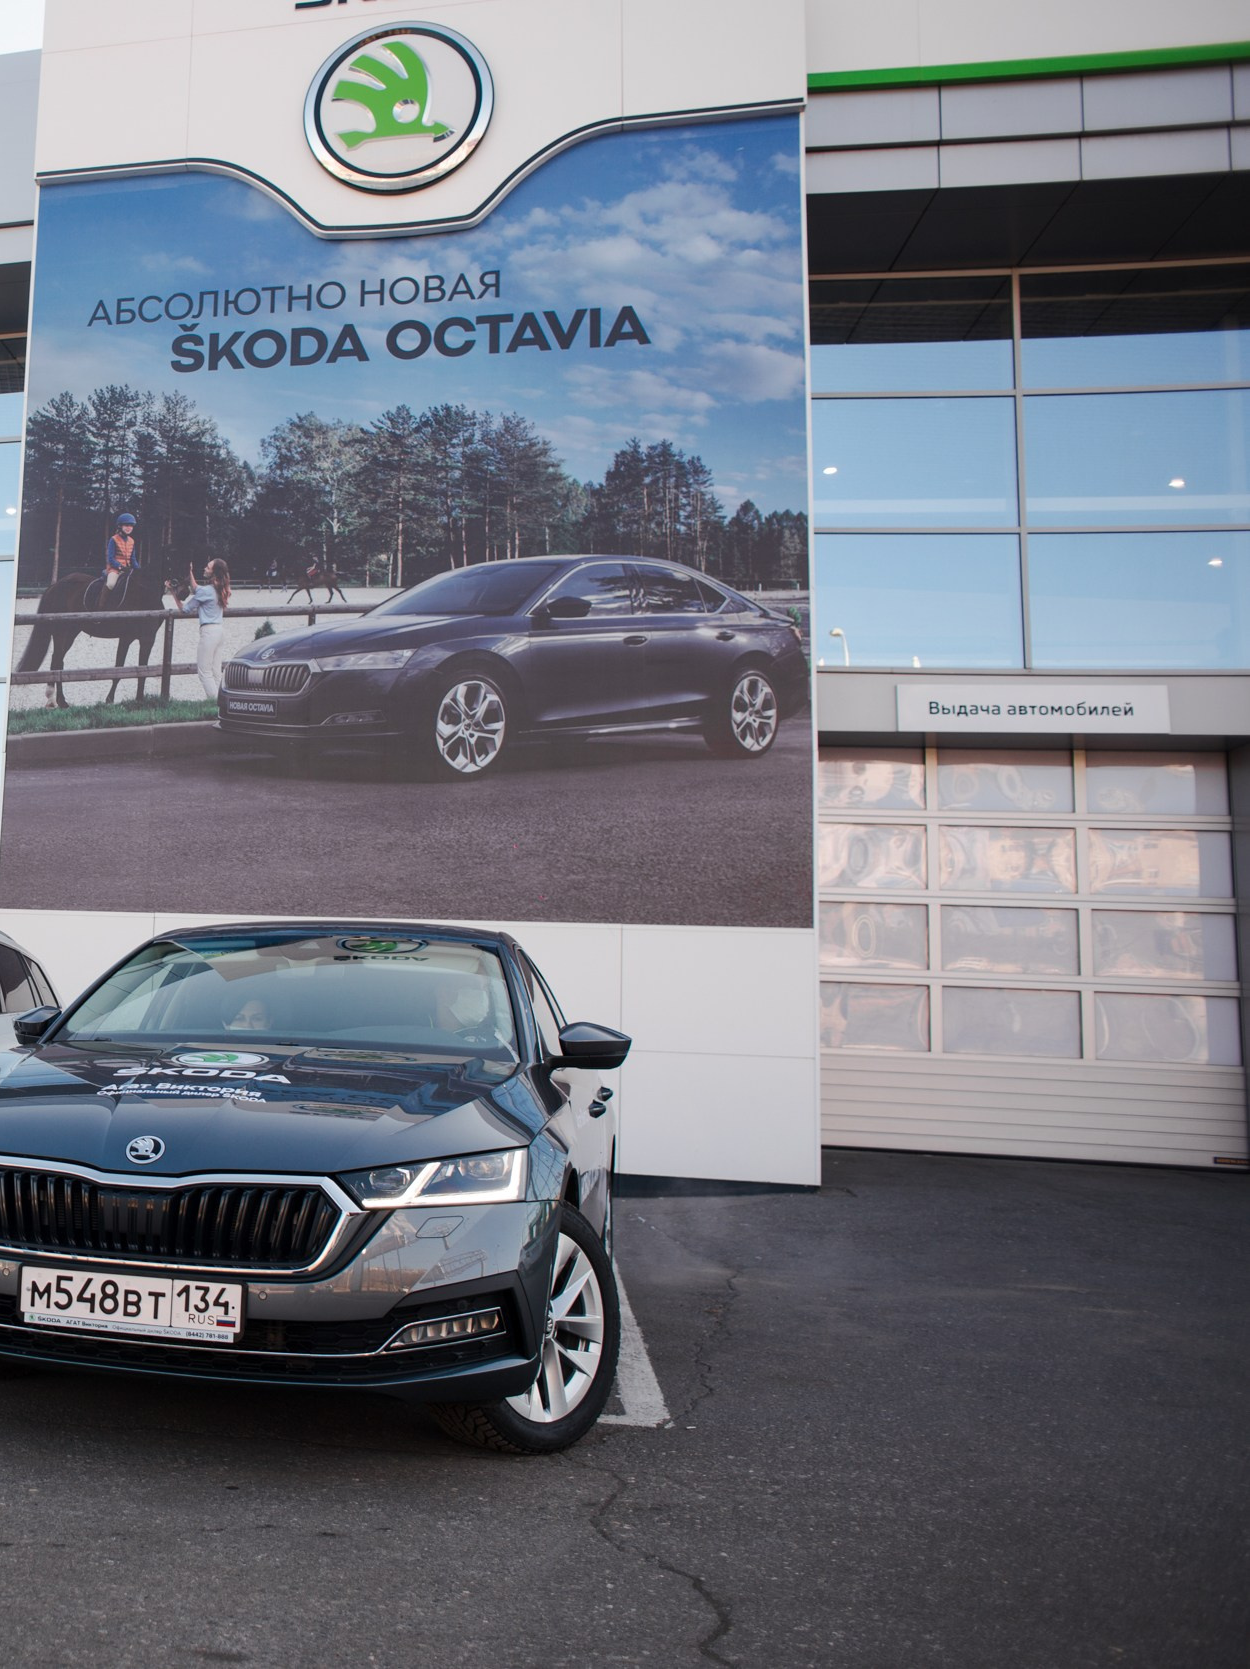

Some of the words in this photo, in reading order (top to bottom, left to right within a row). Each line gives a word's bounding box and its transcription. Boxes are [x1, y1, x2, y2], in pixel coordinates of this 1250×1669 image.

[87, 281, 347, 327] АБСОЛЮТНО
[360, 269, 501, 307] НОВАЯ
[171, 322, 370, 373] ŠKODA
[386, 305, 652, 361] OCTAVIA
[230, 701, 248, 711] НОВАЯ
[248, 703, 274, 713] OCTAVIA
[928, 701, 1001, 718] Выдача
[1007, 701, 1135, 717] автомобилей
[101, 1083, 152, 1091] Агат
[155, 1082, 262, 1098] Виктория
[176, 1284, 230, 1316] 134
[188, 1313, 215, 1327] RUS
